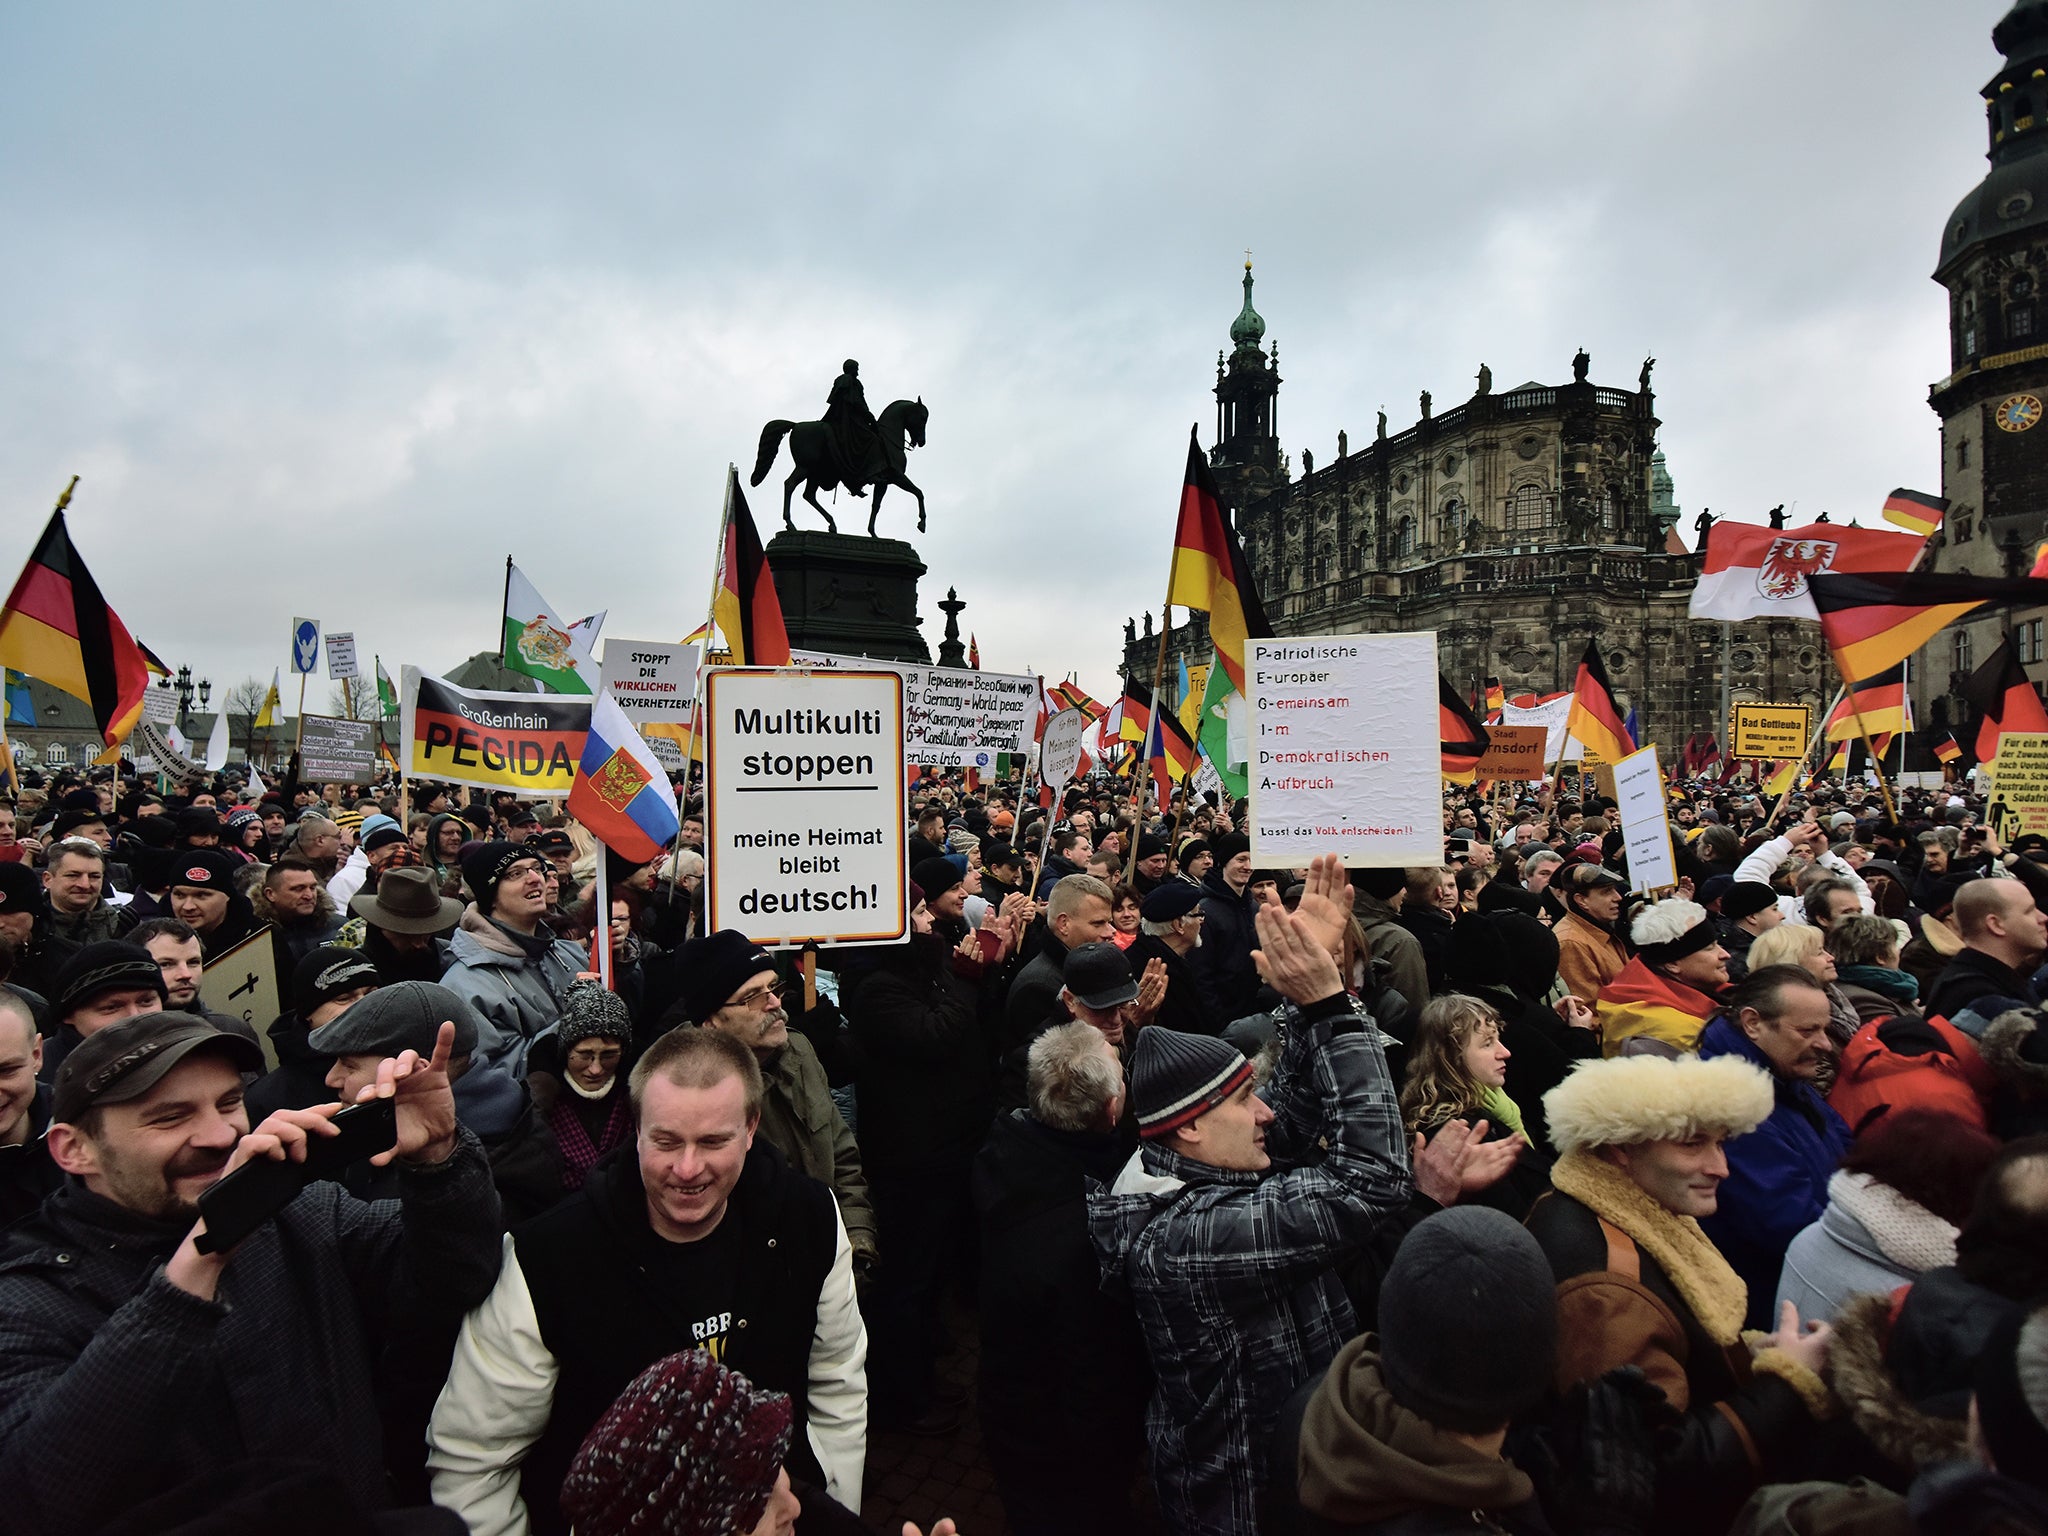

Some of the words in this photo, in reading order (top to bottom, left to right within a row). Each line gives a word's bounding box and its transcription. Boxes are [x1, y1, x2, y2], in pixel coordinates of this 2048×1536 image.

[631, 652, 671, 665] STOPPT
[1256, 645, 1358, 661] P-atriotische
[639, 668, 657, 678] DIE
[1257, 670, 1330, 685] E-uropäer
[614, 680, 677, 692] WIRKLICHEN
[1191, 672, 1206, 693] Fre
[923, 688, 963, 711] Germany
[972, 693, 997, 711] World
[999, 700, 1024, 716] peace
[458, 703, 548, 730] Großenhain
[734, 708, 881, 735] Multikulti
[1742, 717, 1758, 727] Bad
[1761, 718, 1801, 729] Gottleuba
[1260, 723, 1289, 736] I-m
[144, 725, 186, 770] Dezentrale
[653, 739, 680, 748] Patrio
[923, 726, 968, 748] Constitution
[975, 729, 1020, 752] Sovereignty
[1487, 742, 1538, 753] rnsdorf
[424, 721, 574, 777] PEGIDA
[1259, 750, 1389, 764] D-emokratischen
[743, 751, 873, 782] stoppen
[1260, 777, 1334, 790] A-ufbruch
[734, 829, 800, 848] meine
[808, 828, 883, 846] Heimat
[1261, 827, 1290, 836] Lasst
[1293, 826, 1312, 836] das
[1315, 826, 1338, 835] Volk
[1341, 826, 1413, 836] entscheiden!!
[494, 850, 519, 874] NEW
[780, 856, 841, 874] bleibt
[739, 884, 878, 914] deutsch!
